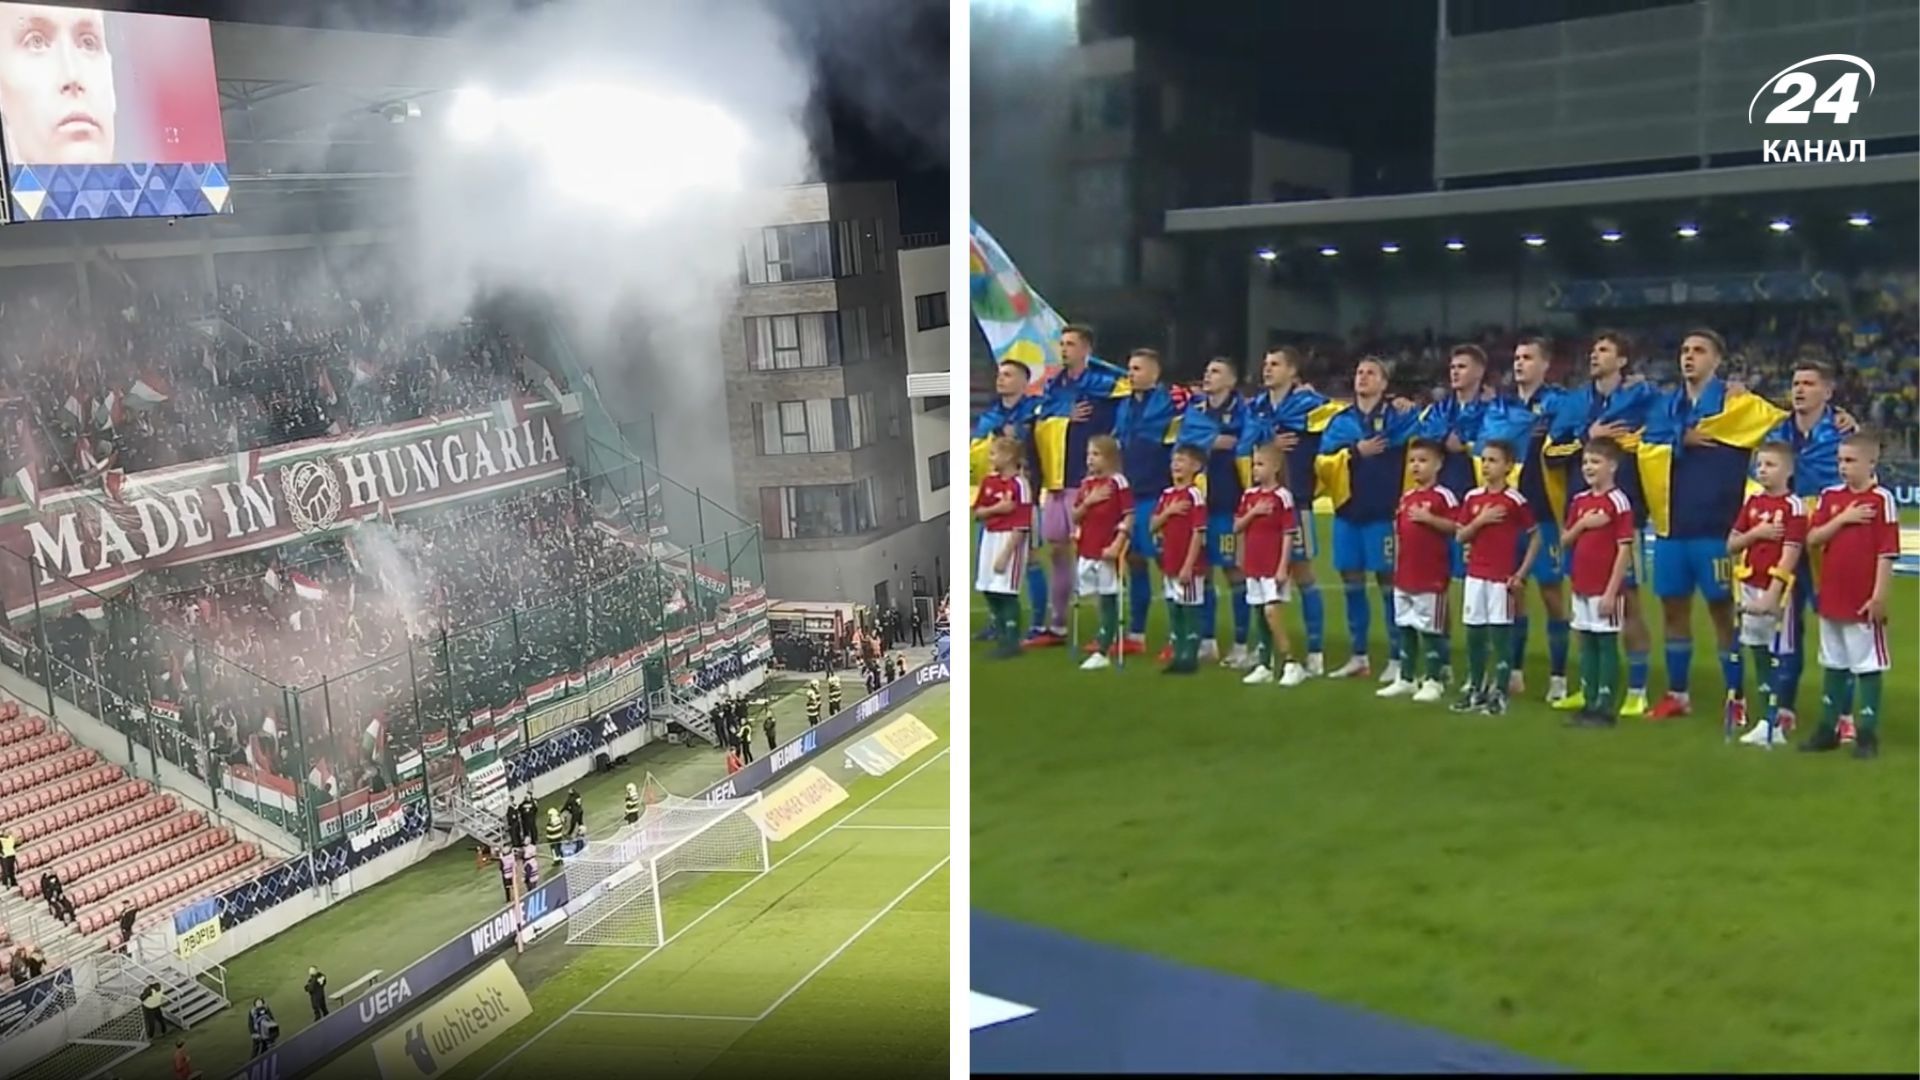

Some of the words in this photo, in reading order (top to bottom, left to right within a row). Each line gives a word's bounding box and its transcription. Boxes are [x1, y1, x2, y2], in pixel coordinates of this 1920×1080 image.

[23, 489, 213, 586] MADE
[213, 474, 279, 538] IN
[916, 663, 950, 685] UEFA
[707, 780, 737, 808] UEFA
[527, 889, 548, 922] ALL
[359, 976, 413, 1023] UEFA
[431, 986, 510, 1056] whitebit
